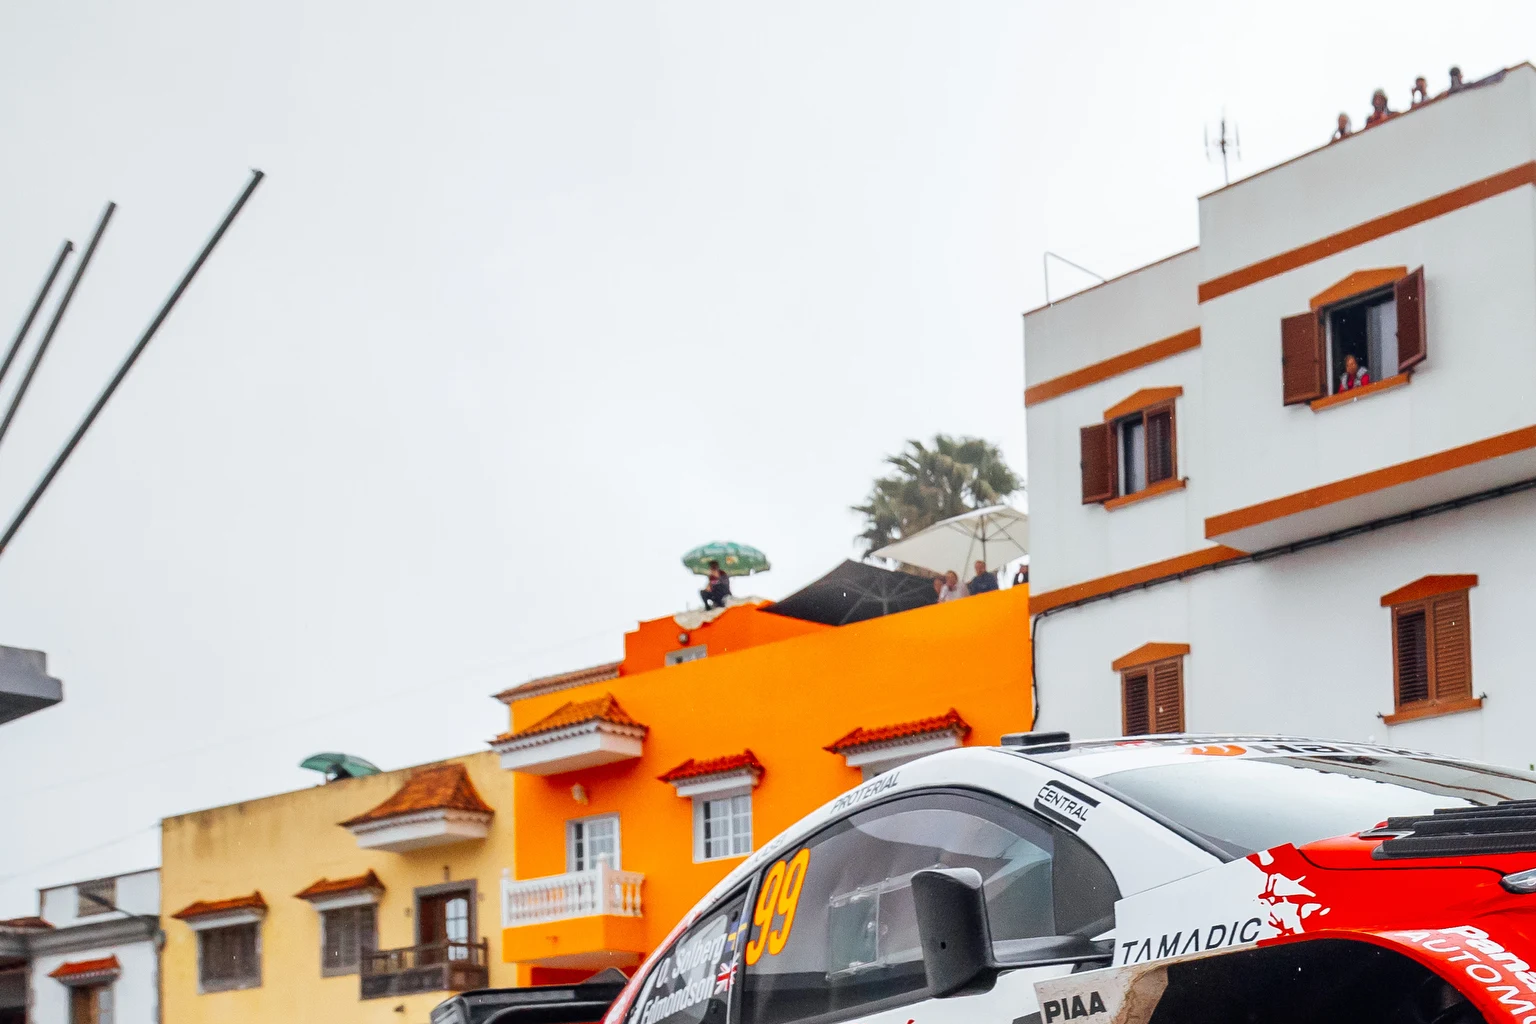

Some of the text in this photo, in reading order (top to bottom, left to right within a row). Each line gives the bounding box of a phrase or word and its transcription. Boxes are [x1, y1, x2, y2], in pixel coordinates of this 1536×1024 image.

[830, 770, 901, 815] PROTERIAL
[1037, 785, 1089, 822] CENTRAL
[745, 847, 811, 967] 99
[671, 932, 728, 979] Solberg
[1120, 916, 1263, 966] TAMADIC
[1043, 991, 1107, 1024] PIAA
